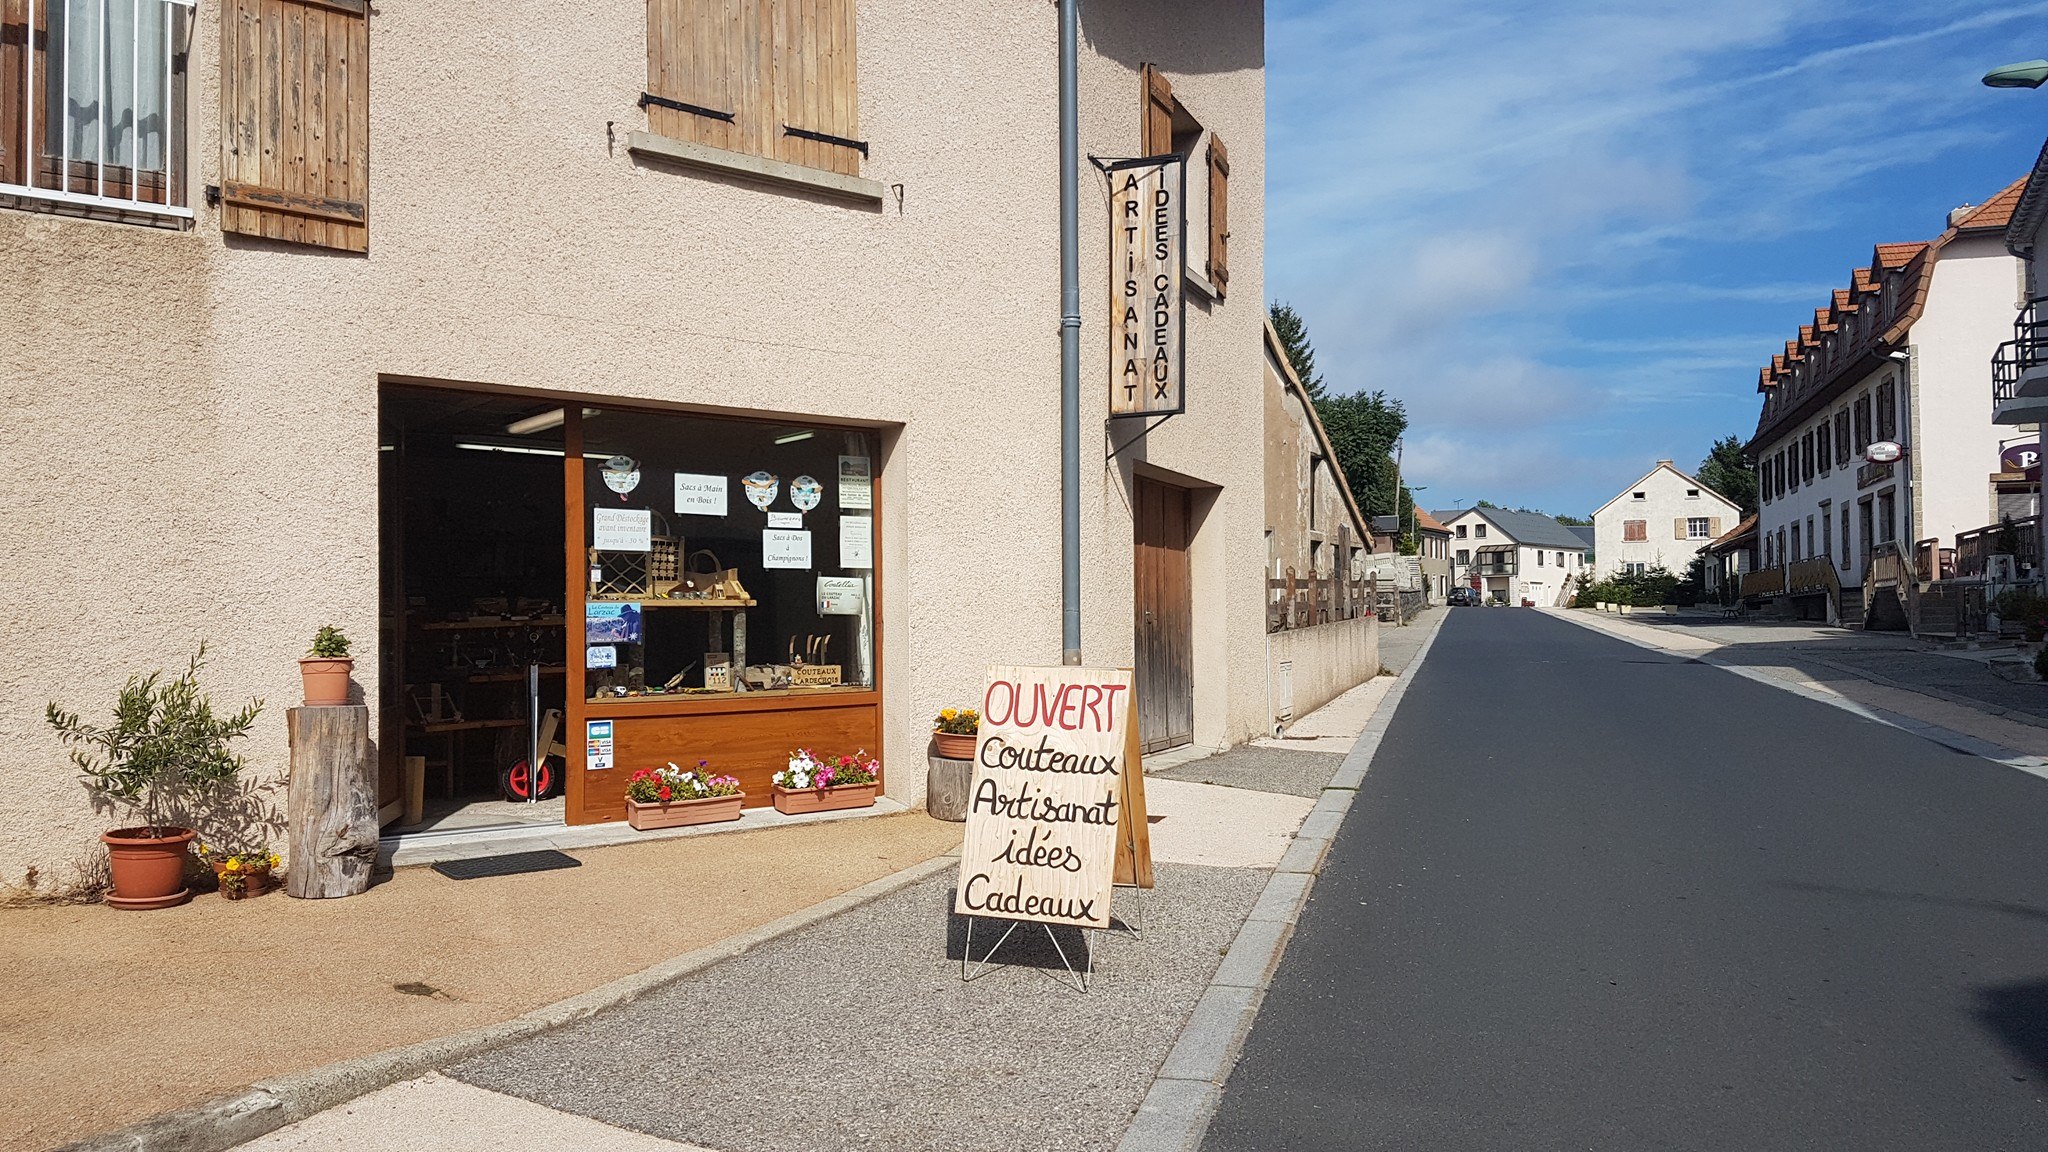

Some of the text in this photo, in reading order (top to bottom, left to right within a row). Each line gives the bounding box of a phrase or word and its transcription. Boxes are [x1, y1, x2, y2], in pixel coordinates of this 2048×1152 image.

[1154, 275, 1169, 399] CADEAUX
[680, 483, 696, 491] Sacs
[704, 485, 723, 493] Main
[696, 496, 712, 504] Bois
[596, 513, 616, 524] Grand
[588, 607, 615, 616] Larzac
[796, 668, 837, 676] COUTEAUX
[984, 680, 1127, 733] OUVERT
[980, 734, 1120, 776] Couteaux
[973, 778, 1119, 826] Artisanat
[991, 826, 1082, 873] idées
[964, 873, 1100, 922] Cadeaux
